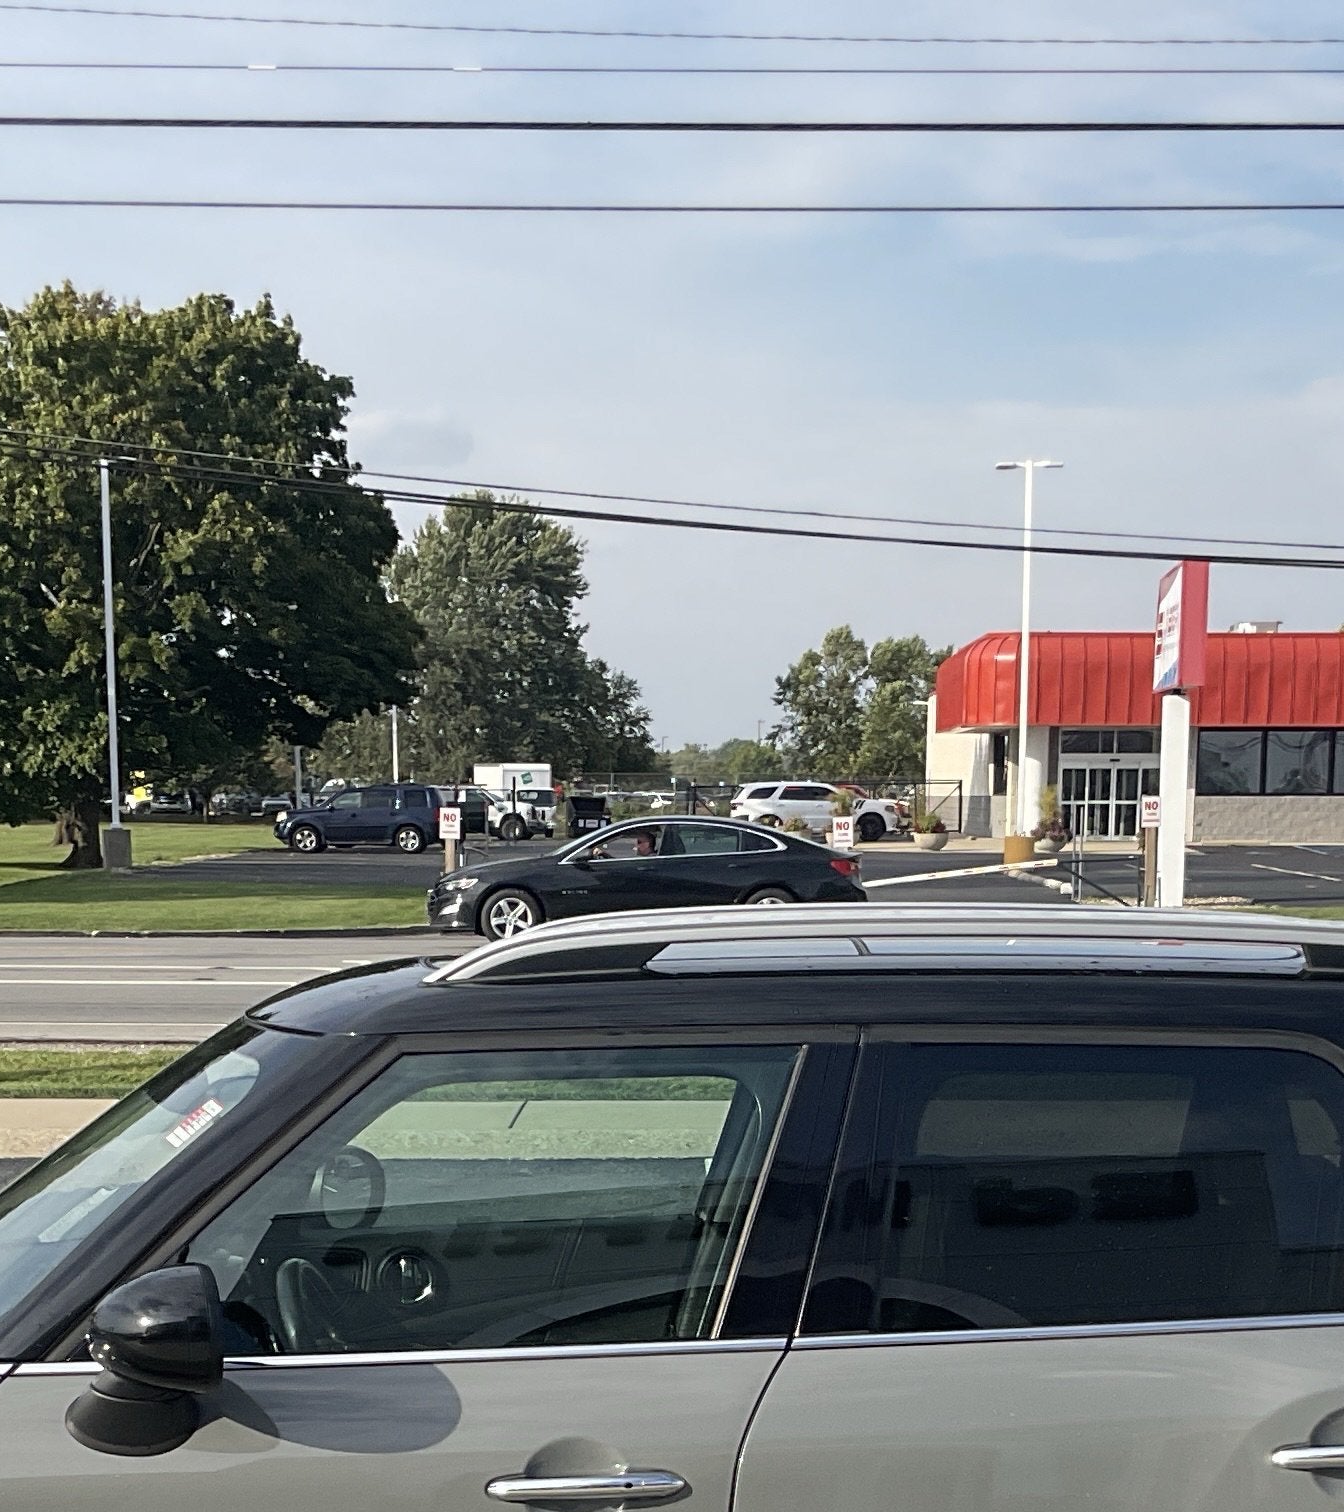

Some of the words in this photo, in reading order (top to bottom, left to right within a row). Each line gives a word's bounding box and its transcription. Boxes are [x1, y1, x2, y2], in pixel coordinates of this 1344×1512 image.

[1144, 801, 1159, 811] NO
[443, 813, 457, 822] NO
[836, 821, 850, 831] NO
